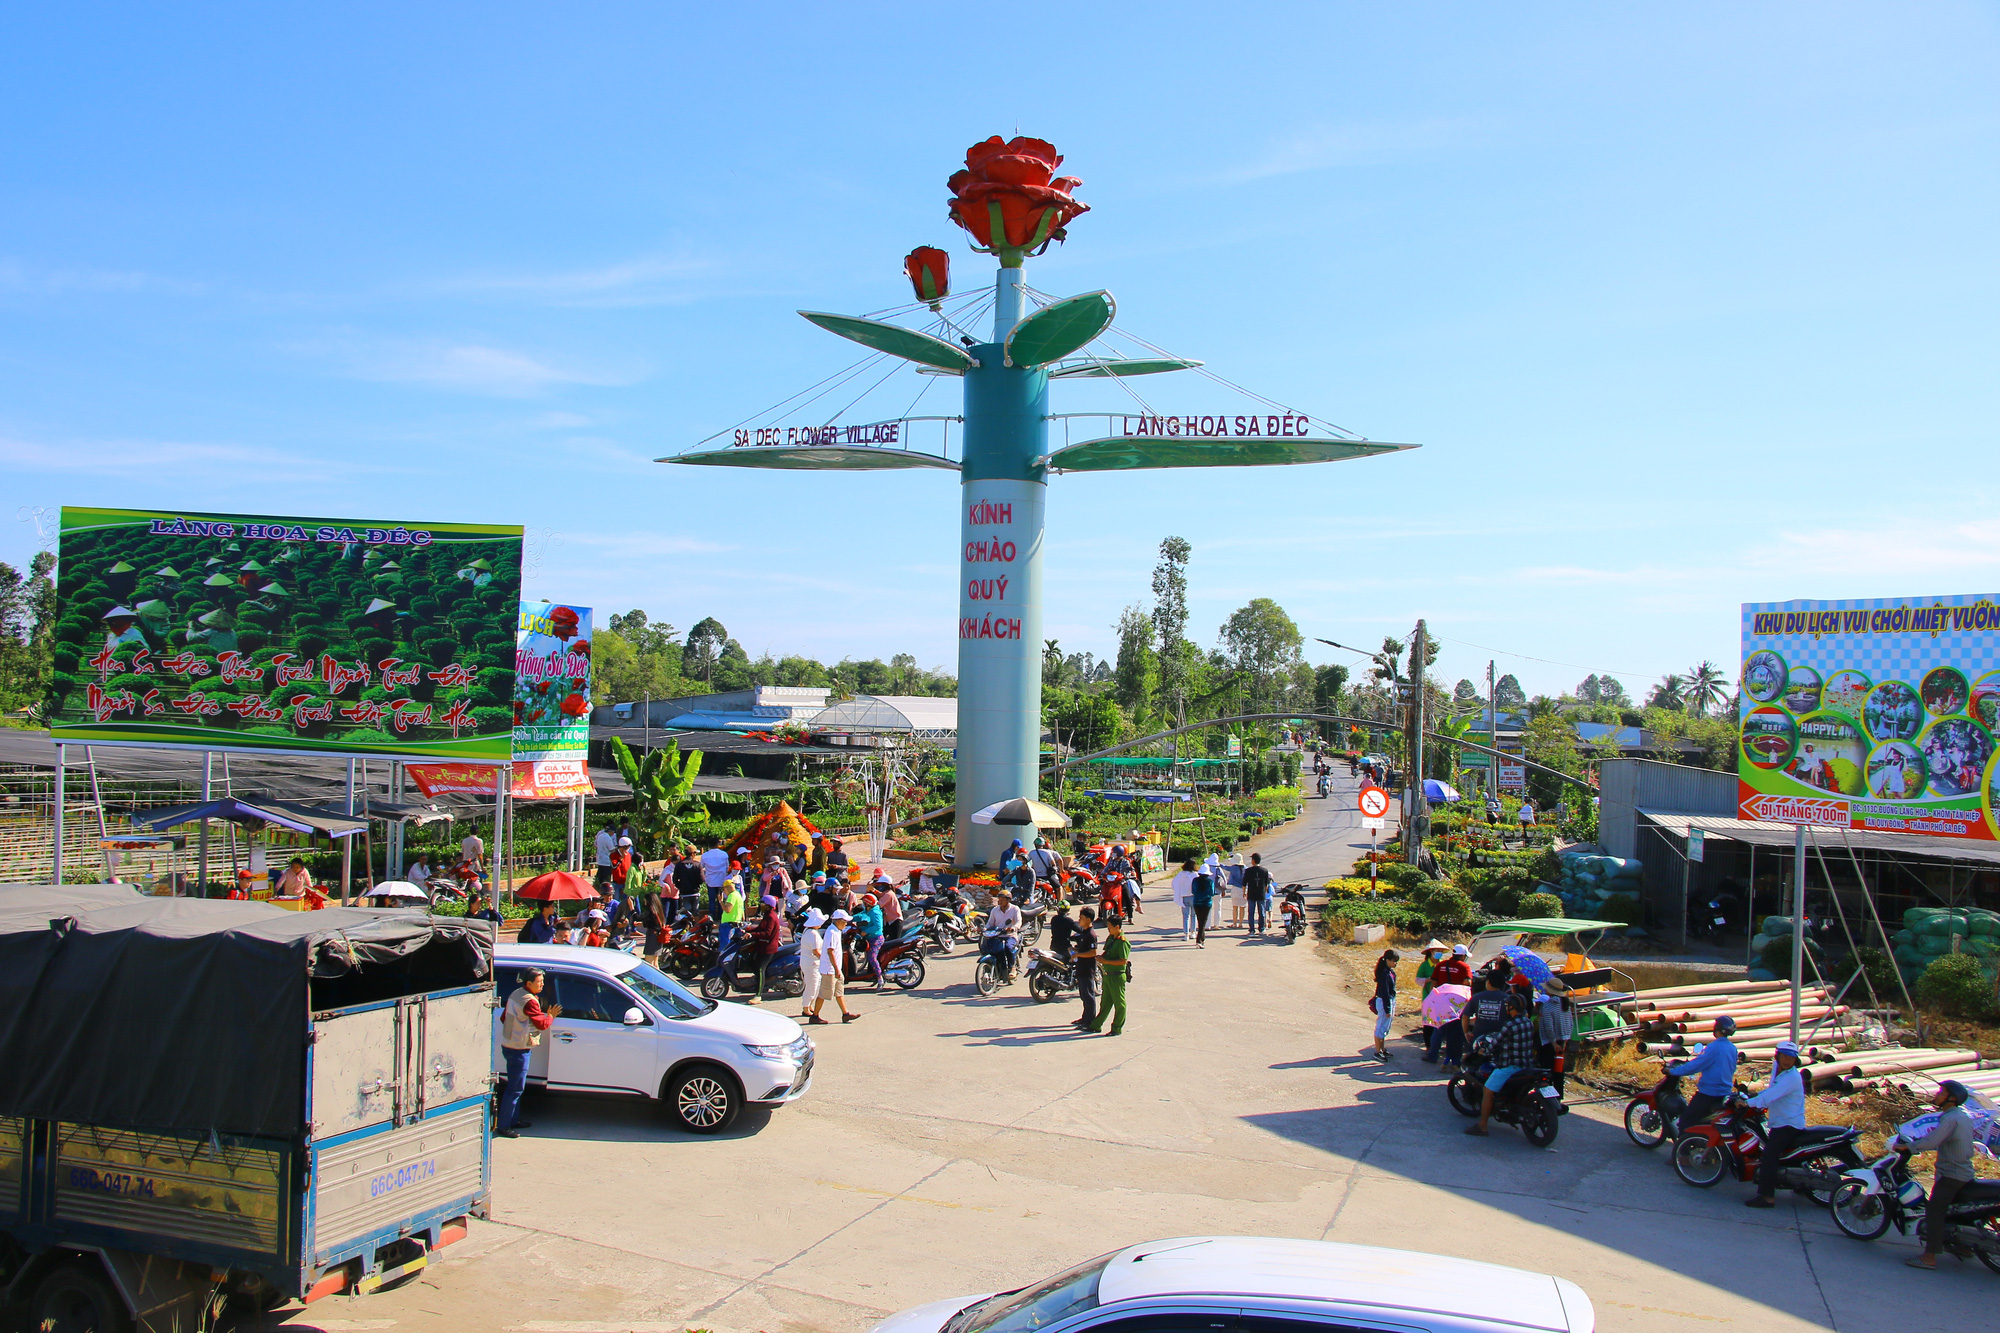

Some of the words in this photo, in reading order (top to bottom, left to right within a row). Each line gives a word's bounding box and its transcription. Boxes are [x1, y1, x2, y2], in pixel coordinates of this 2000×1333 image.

[734, 429, 750, 447] SA
[757, 428, 781, 446] DEC
[788, 426, 837, 445] FLOWER
[847, 424, 899, 443] VILLAGE
[1124, 411, 1180, 436] LÀNG
[1187, 415, 1228, 436] HOA
[1235, 415, 1260, 436] SA
[1267, 410, 1309, 436] ĐÉC
[969, 499, 1012, 525] KÍNH
[150, 518, 233, 537] LÀNG
[243, 524, 308, 541] HOA
[317, 527, 358, 543] SA
[365, 526, 432, 545] ĐÉC
[966, 536, 1016, 562] CHÀO
[968, 575, 1009, 600] QUÝ
[520, 612, 555, 637] LỊCH
[959, 612, 1021, 639] KHÁCH
[1754, 613, 1785, 635] KHU
[1785, 612, 1808, 634] DU
[1807, 611, 1842, 640] LỊCH
[1843, 610, 1870, 634] VUI
[1871, 604, 1911, 633] CHƠI
[1910, 601, 1952, 638] MIỆT
[90, 644, 125, 682] Hoa
[133, 649, 154, 675] Sa
[546, 650, 563, 677] Sa
[566, 652, 588, 678] Đéc
[143, 689, 165, 715] Sa
[440, 699, 477, 739] Hoa
[1761, 804, 1772, 816] ĐI
[1776, 801, 1811, 819] THẲNG
[1815, 808, 1847, 822] 700m
[1915, 808, 1927, 817] HOA
[1944, 823, 1952, 832] SA
[70, 1168, 154, 1198] 66C-047.74
[371, 1159, 435, 1197] 66C-047.74
